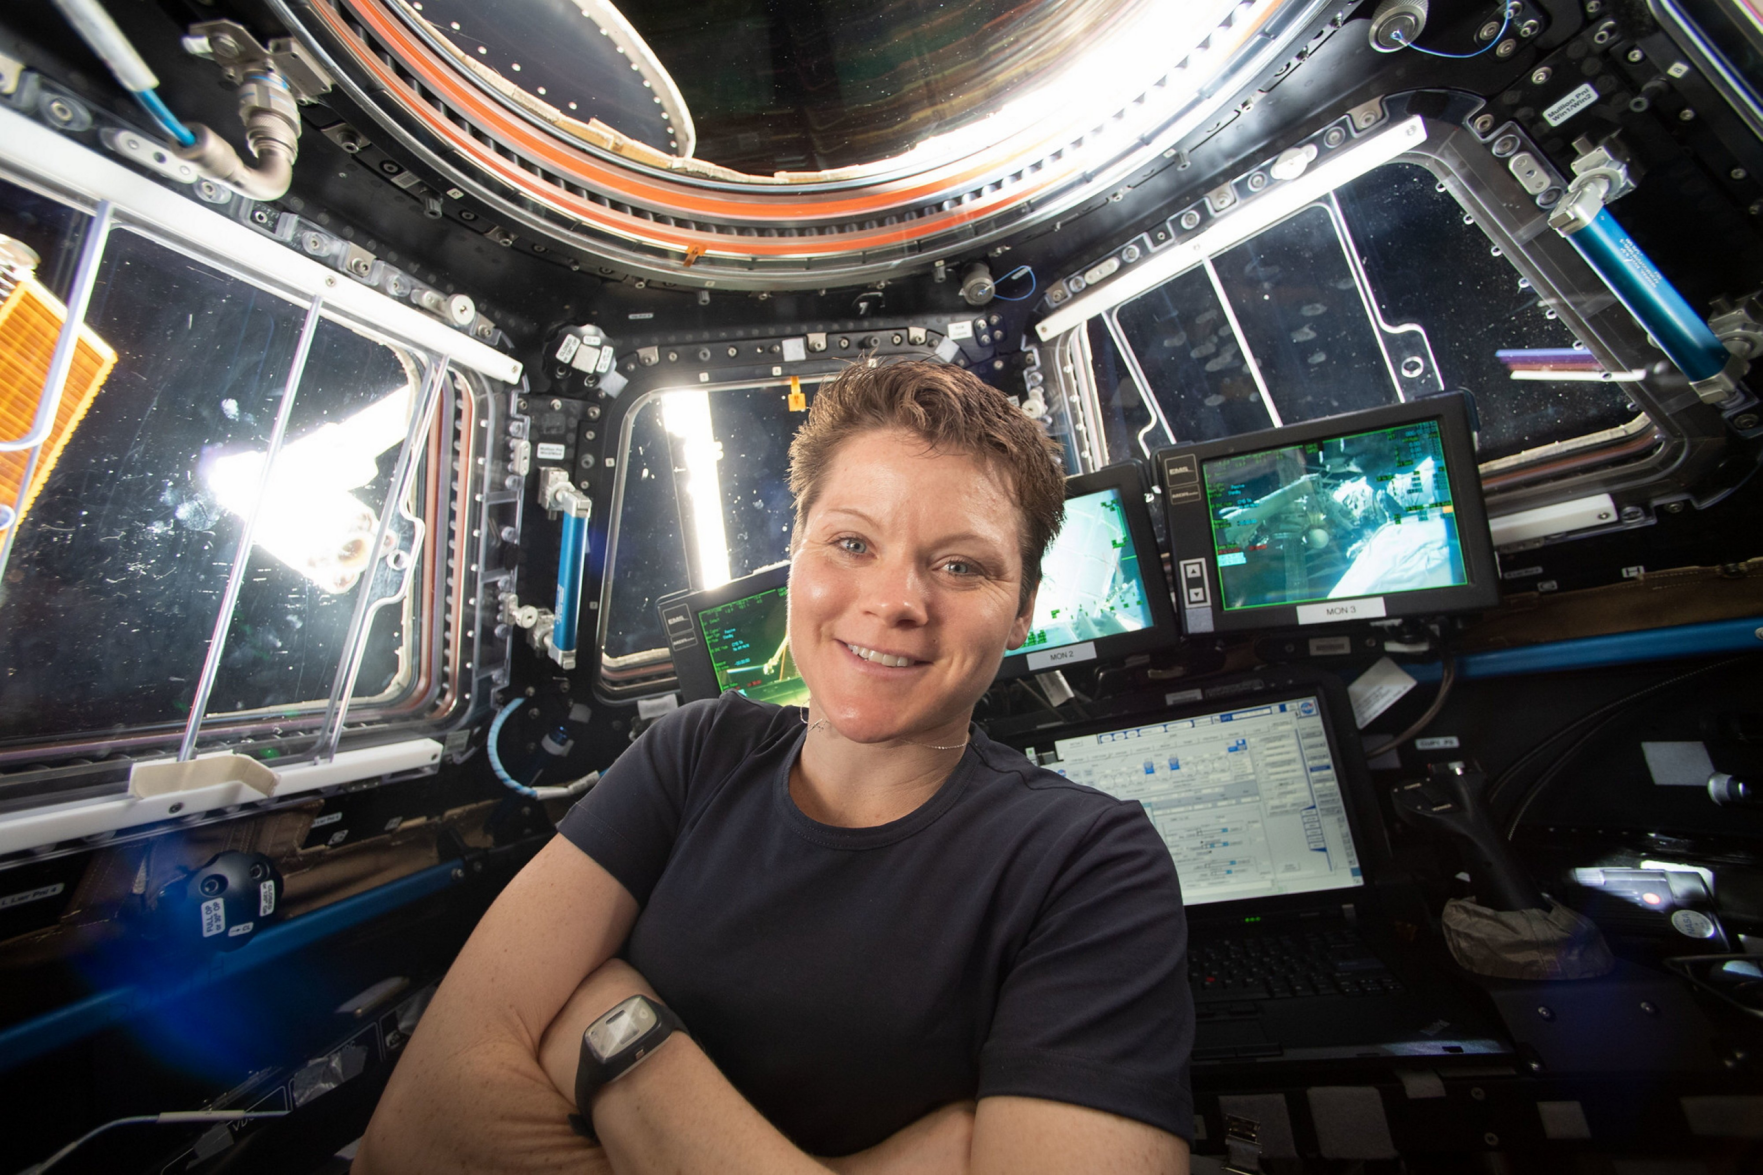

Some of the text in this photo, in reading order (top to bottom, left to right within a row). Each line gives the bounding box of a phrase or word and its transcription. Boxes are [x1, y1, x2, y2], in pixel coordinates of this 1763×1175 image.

[1547, 98, 1576, 118] Mullion
[1326, 605, 1357, 616] MON 3
[1050, 652, 1068, 662] MON
[212, 901, 220, 911] OP
[204, 905, 214, 933] FULL OP
[1682, 913, 1695, 935] NASA
